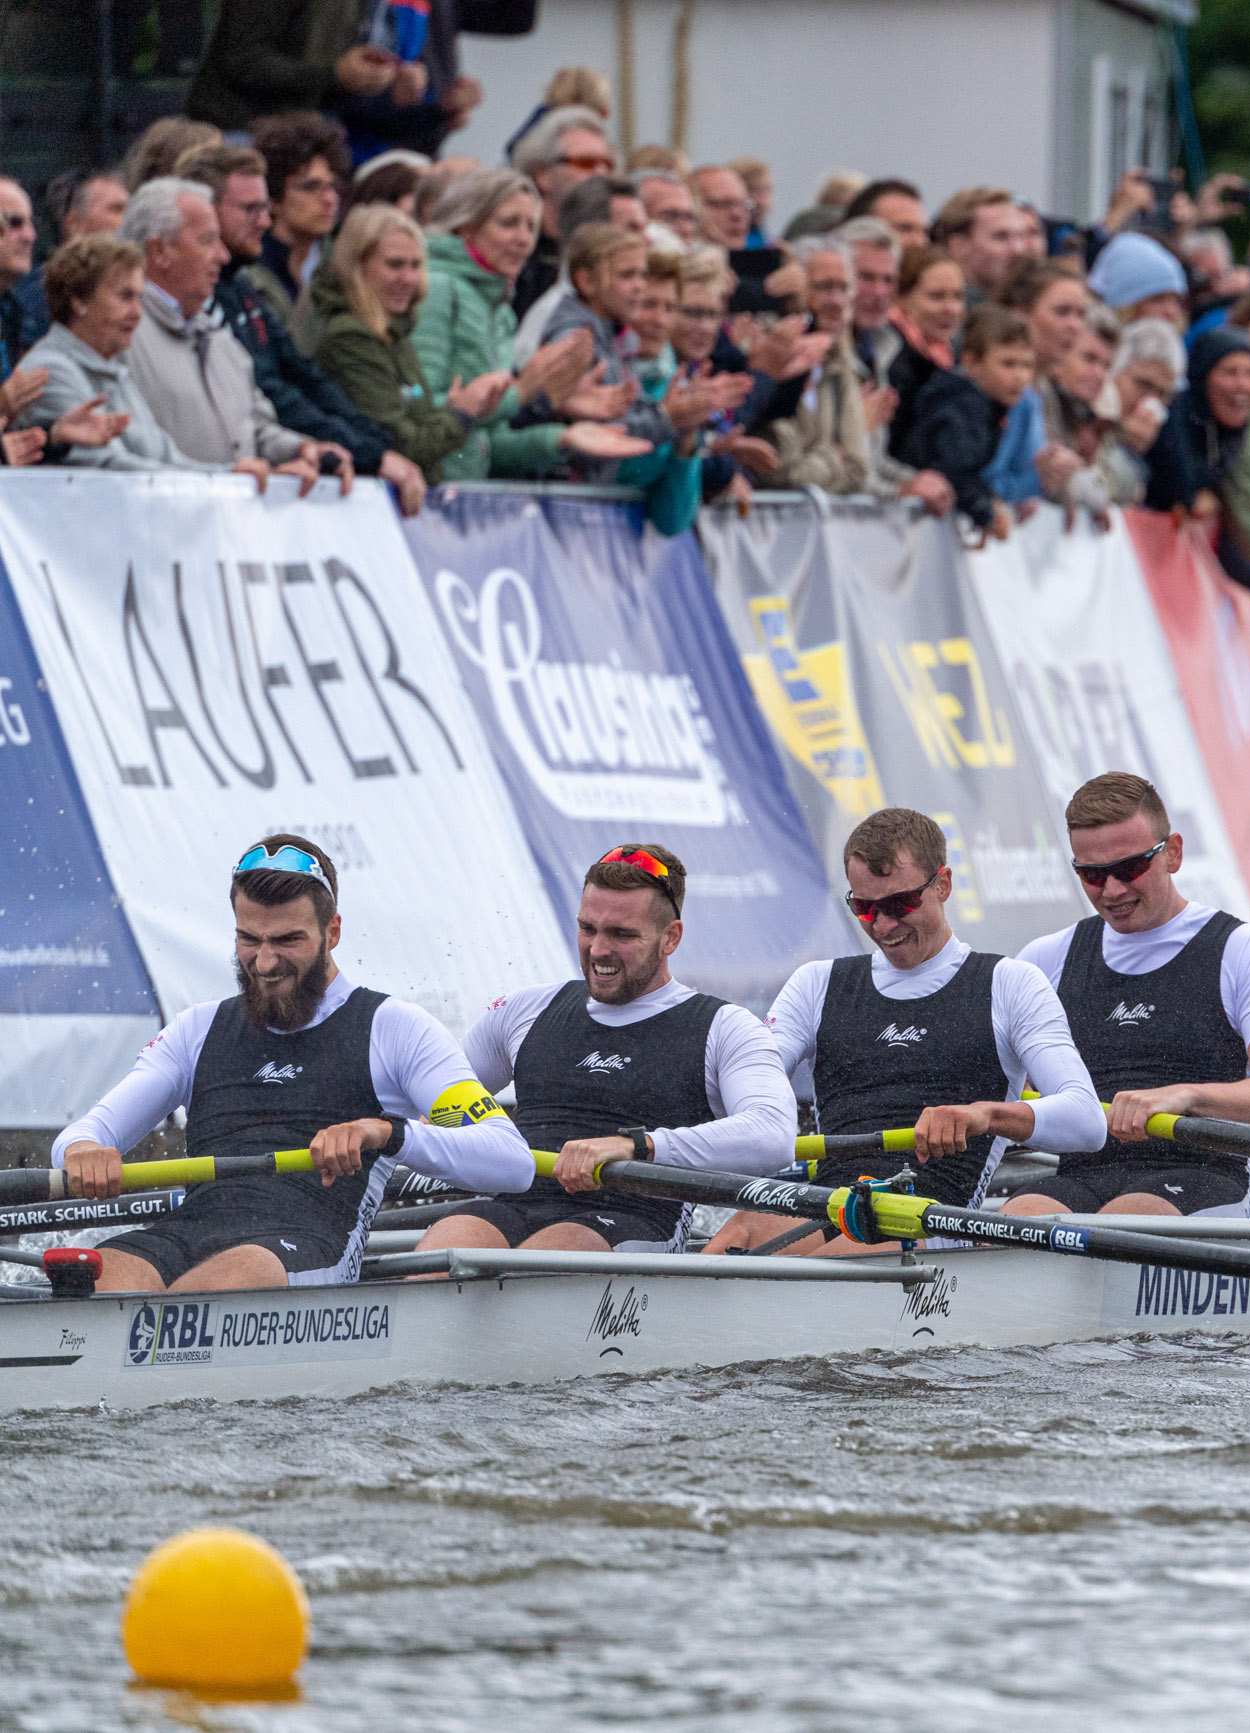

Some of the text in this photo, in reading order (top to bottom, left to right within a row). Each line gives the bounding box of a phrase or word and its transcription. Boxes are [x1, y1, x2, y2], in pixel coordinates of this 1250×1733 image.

[0, 1210, 53, 1229] STARK.
[54, 1203, 128, 1223] SCHNELL.
[130, 1199, 166, 1215] GUT.
[927, 1214, 965, 1233] STARK.
[966, 1220, 1020, 1241] SCHNELL.
[1021, 1227, 1047, 1245] GUT.
[1054, 1230, 1086, 1248] RBL
[1135, 1264, 1250, 1316] MINDEN
[157, 1303, 389, 1349] RBL RUDER-BUNDESLIGA
[155, 1350, 211, 1362] RUDER-BUNDESLIGA
